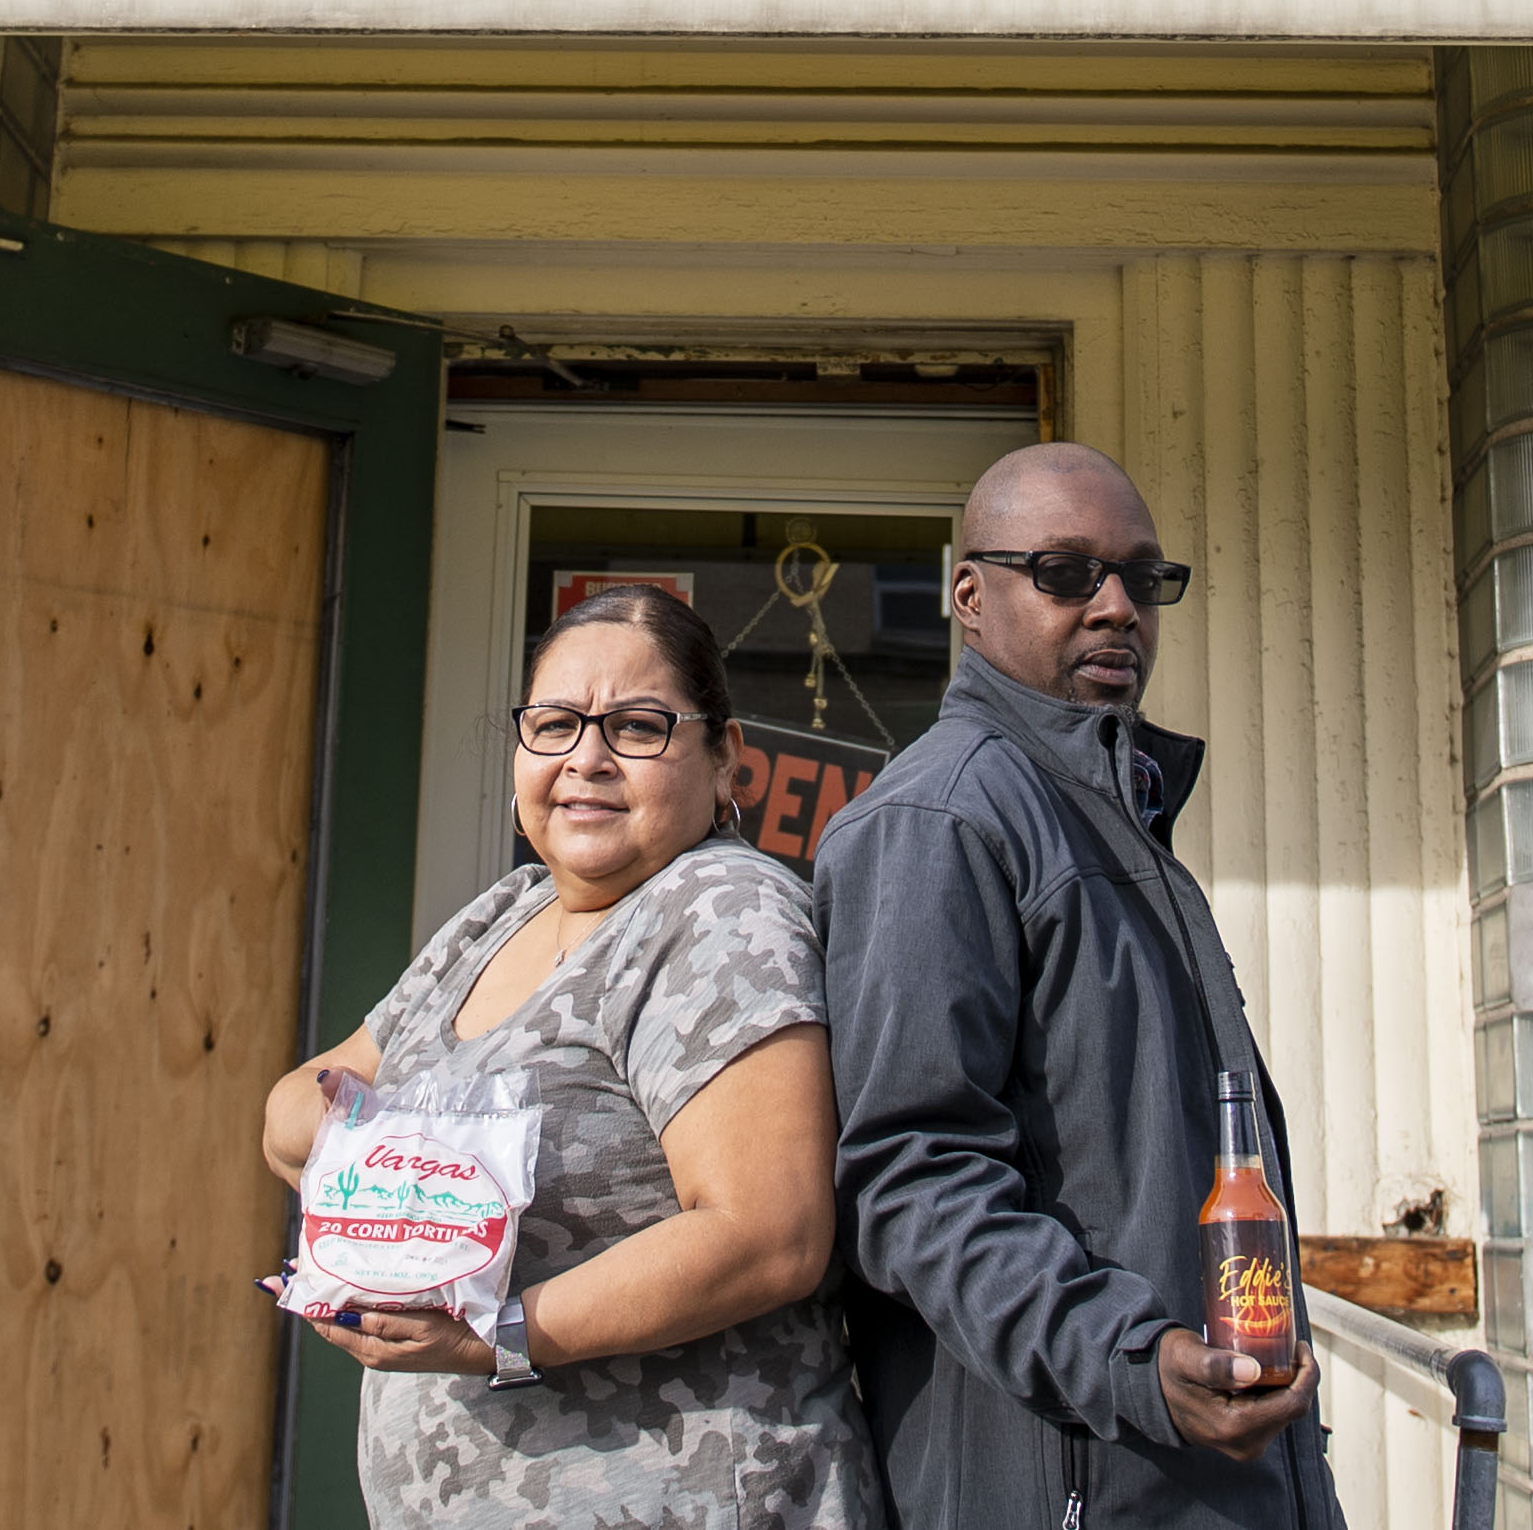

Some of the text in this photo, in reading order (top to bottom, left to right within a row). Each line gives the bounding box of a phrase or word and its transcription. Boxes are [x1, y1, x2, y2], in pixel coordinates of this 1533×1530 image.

[721, 745, 874, 861] PEN
[365, 1144, 481, 1181] Vargas
[318, 1221, 343, 1233] 20
[346, 1222, 399, 1240] CORN
[1218, 1255, 1292, 1301] Eddie's
[1230, 1295, 1290, 1307] HOT SAUCE
